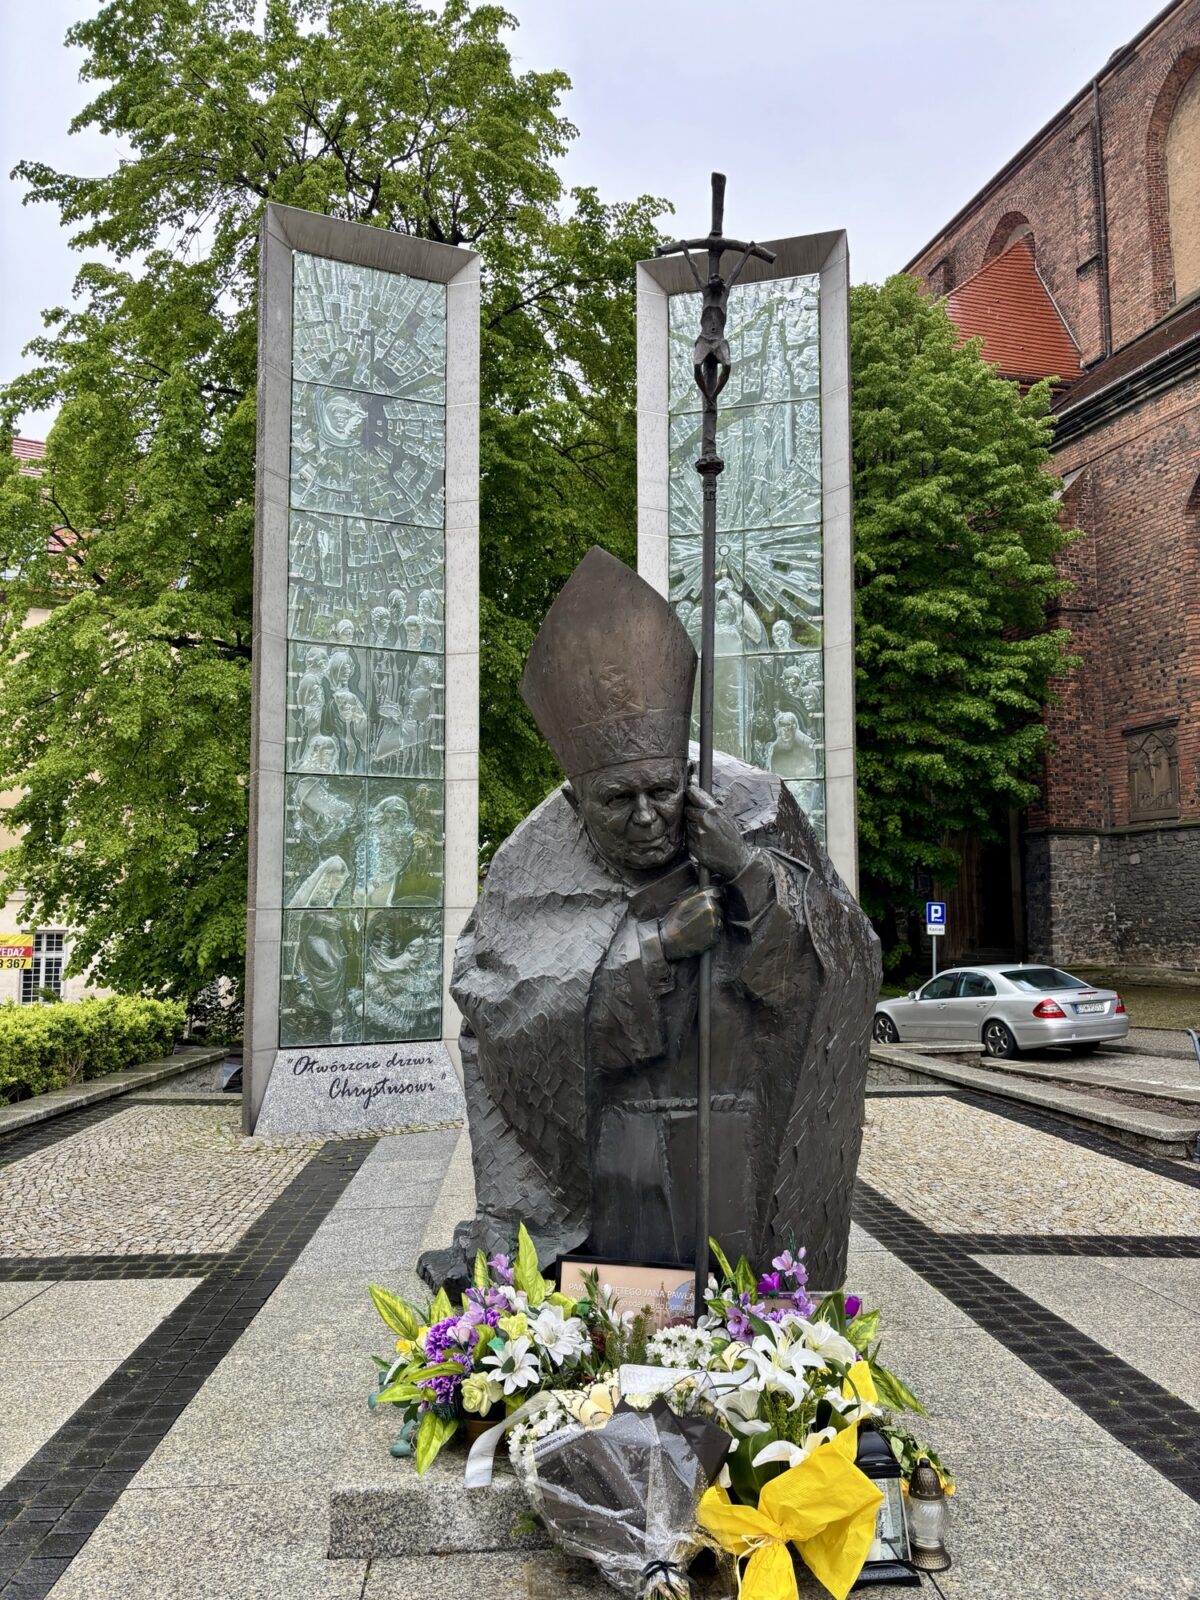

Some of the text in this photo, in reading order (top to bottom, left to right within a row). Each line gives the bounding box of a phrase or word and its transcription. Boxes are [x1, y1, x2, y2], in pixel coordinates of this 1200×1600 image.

[931, 905, 942, 922] P
[0, 947, 25, 957] EDAŻ
[6, 958, 26, 969] 367
[386, 1052, 433, 1067] drzwi
[644, 1289, 665, 1298] JANA
